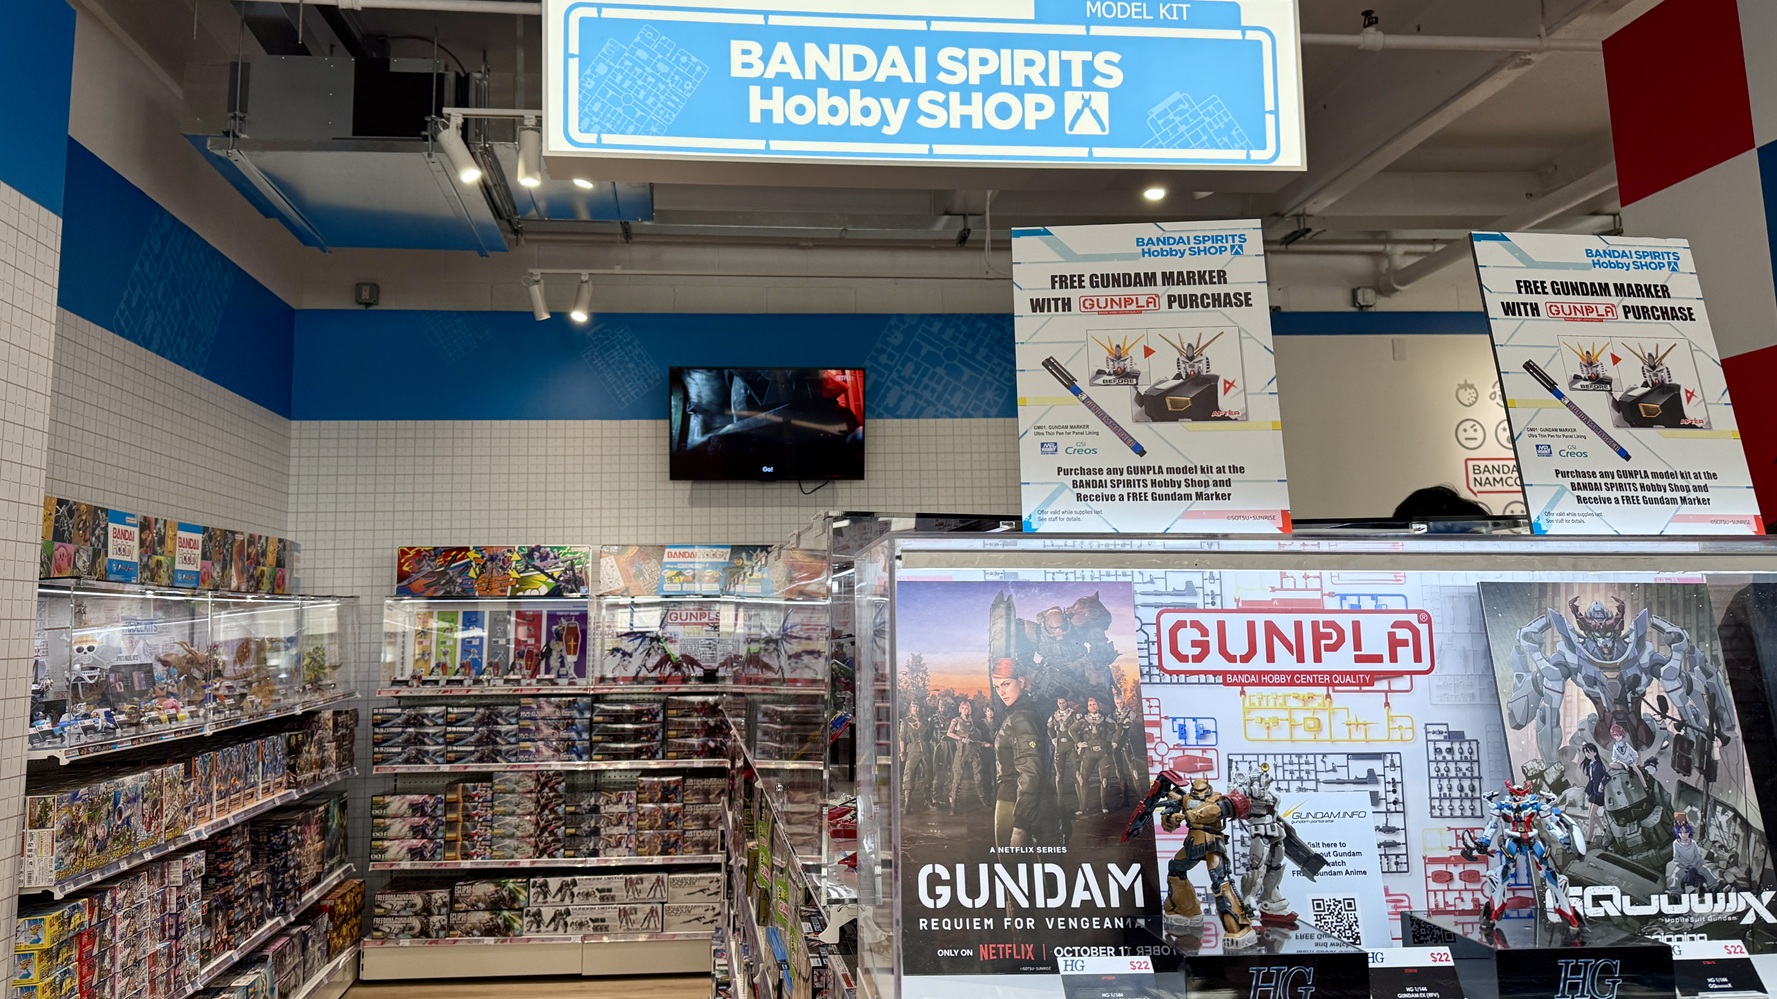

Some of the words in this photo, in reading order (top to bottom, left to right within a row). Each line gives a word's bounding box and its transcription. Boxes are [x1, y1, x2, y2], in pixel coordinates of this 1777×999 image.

[1086, 1, 1154, 19] MODEL
[1159, 3, 1192, 20] KIT
[730, 40, 927, 84] BANDAI
[935, 46, 1124, 89] SPIRITS
[748, 85, 910, 136] Hobby
[916, 91, 1055, 132] SHOP
[1135, 235, 1191, 248] BANDAI
[1192, 233, 1247, 246] SPIRITS
[1141, 247, 1187, 258] Hobby
[1188, 246, 1228, 256] SHOP
[1584, 249, 1632, 260] BANDAI
[1634, 250, 1681, 261] SPIRITS
[1591, 259, 1631, 271] Hobby
[1632, 261, 1666, 270] SHOP
[1050, 273, 1086, 290] FREE
[1089, 271, 1158, 289] GUNDAM
[1161, 269, 1228, 287] MARKER
[1515, 280, 1549, 295] FREE
[1551, 281, 1611, 297] GUNDAM
[1613, 283, 1671, 299] MARKER
[1029, 297, 1072, 313] WITH
[1082, 295, 1158, 310] GUNPLA
[1167, 291, 1253, 310] PURCHASE
[1500, 301, 1541, 317] WITH
[1548, 304, 1616, 318] GUNPLA
[1622, 305, 1696, 322] PURCHASE
[1065, 447, 1098, 455] Creos
[1558, 449, 1589, 458] Creos
[1057, 466, 1104, 476] Purchase
[1106, 468, 1124, 477] any
[1126, 466, 1164, 475] GUNPLA
[1166, 465, 1198, 475] model
[1200, 465, 1214, 475] kit
[1215, 466, 1226, 474] at
[1228, 465, 1246, 474] the
[1472, 464, 1518, 475] BANDA
[1555, 469, 1597, 480] Purchase
[1598, 471, 1615, 481] any
[1616, 469, 1649, 480] GUNPLA
[1651, 470, 1678, 480] model
[1679, 470, 1692, 480] kit
[1694, 471, 1703, 480] at
[1704, 470, 1718, 480] the
[1072, 479, 1108, 489] BANDAI
[1110, 478, 1148, 488] SPIRITS
[1150, 478, 1182, 489] Hobby
[1184, 478, 1210, 489] Shop
[1212, 478, 1232, 488] and
[1570, 482, 1603, 492] BANDAI
[1605, 482, 1638, 492] SPIRITS
[1639, 483, 1667, 493] Hobby
[1668, 483, 1691, 494] Shop
[1692, 484, 1709, 493] and
[1076, 492, 1116, 502] Receive
[1118, 494, 1125, 502] a
[1126, 492, 1149, 502] FREE
[1151, 491, 1193, 501] Gundam
[1195, 491, 1232, 501] Marker
[1576, 495, 1612, 505] Receive
[1621, 495, 1641, 505] FREE
[1642, 495, 1679, 505] Gundam
[1680, 496, 1711, 506] Marker
[112, 527, 135, 542] BANDAI
[178, 537, 199, 550] BANDAI
[1168, 619, 1422, 664] GUNPLA
[1226, 674, 1259, 684] BANDAI
[1261, 674, 1293, 684] HOBBY
[1294, 674, 1331, 683] CENTER
[1332, 674, 1371, 684] QUALITY
[1291, 811, 1367, 820] GUNDAM.INFO
[998, 846, 1034, 854] NETFLIX
[917, 863, 1145, 909] GUNDAM
[919, 918, 995, 931] REQUIEM
[1004, 917, 1036, 930] FOR
[1046, 917, 1124, 930] VENGEAN
[937, 949, 959, 957] ONLY
[979, 944, 1035, 961] NETFLIX
[1053, 946, 1117, 958] OCTOBER
[1671, 944, 1682, 956] G
[1724, 945, 1746, 955] $22
[1429, 952, 1451, 963] $22
[1063, 958, 1086, 972] HG
[1129, 960, 1150, 971] $22
[1248, 966, 1316, 999] HG
[1554, 959, 1622, 999] HG
